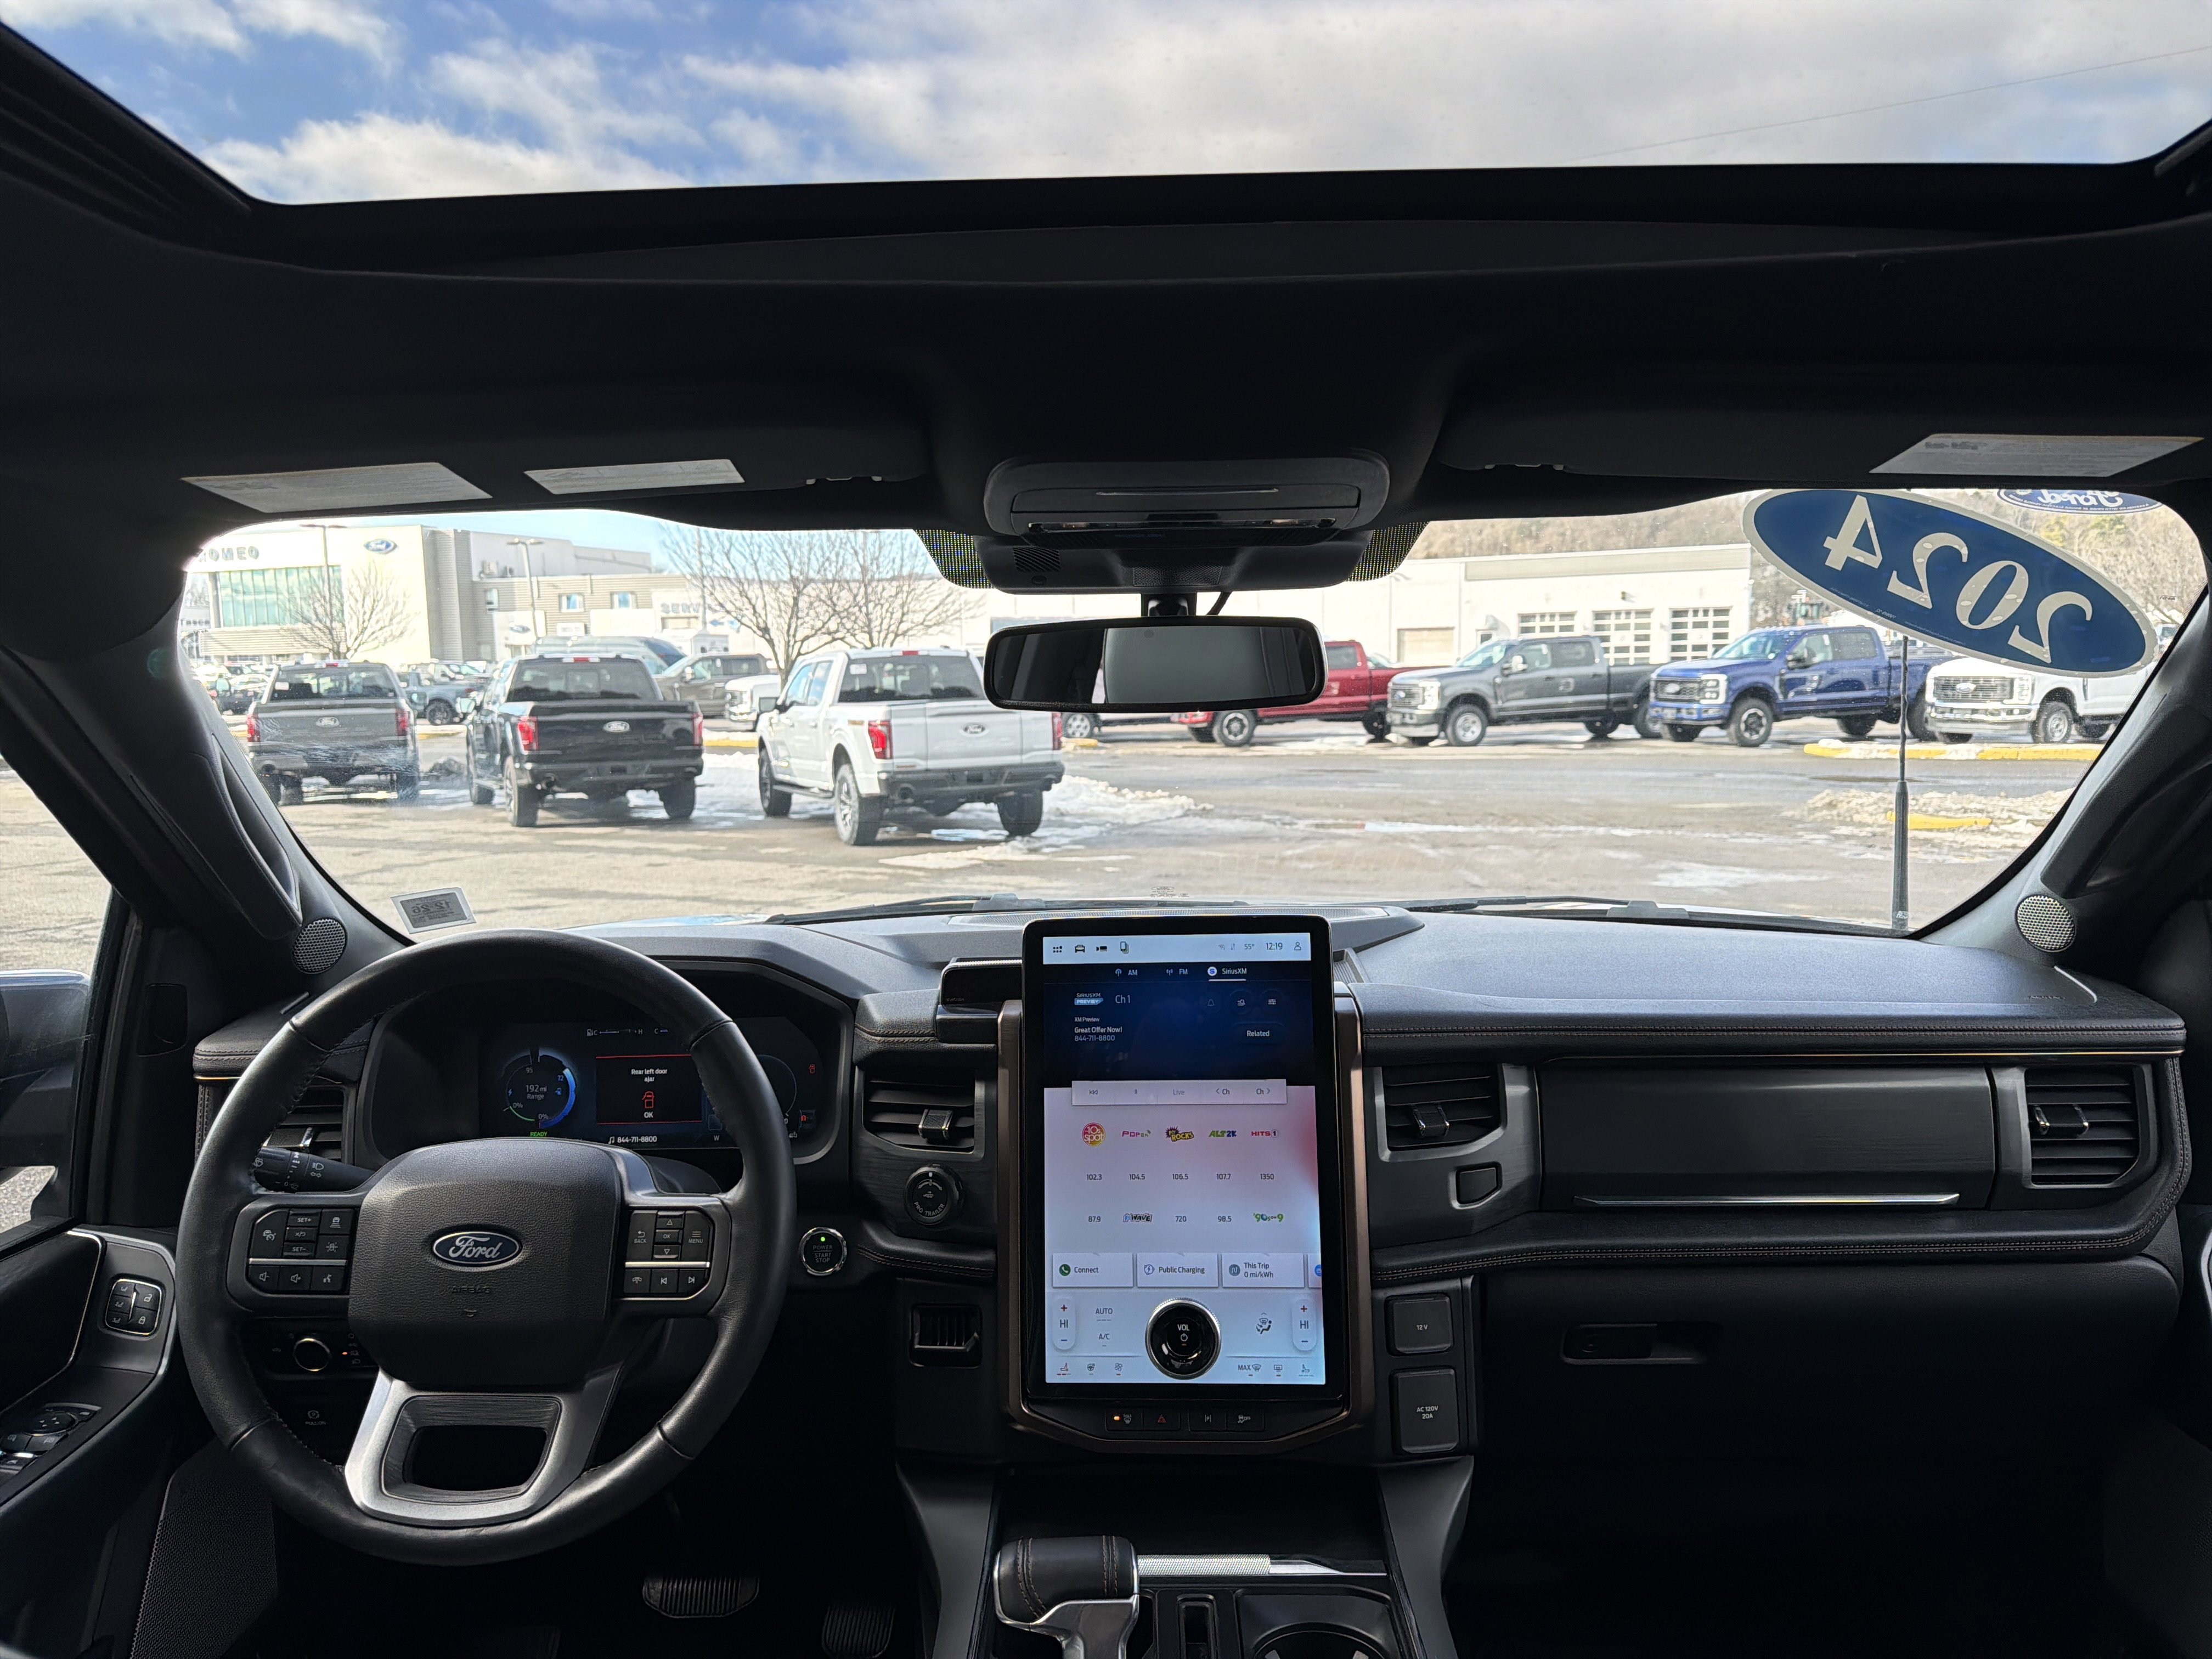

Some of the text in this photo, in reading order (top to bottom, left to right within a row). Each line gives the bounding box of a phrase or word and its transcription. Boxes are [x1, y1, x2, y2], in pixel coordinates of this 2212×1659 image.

[1115, 995, 1126, 1003] Ch
[1084, 1134, 1104, 1143] spot
[914, 1201, 945, 1216] PRO TRAILER
[449, 1238, 502, 1259] Ford
[1178, 1267, 1205, 1275] Charging
[1300, 1321, 1308, 1329] HI
